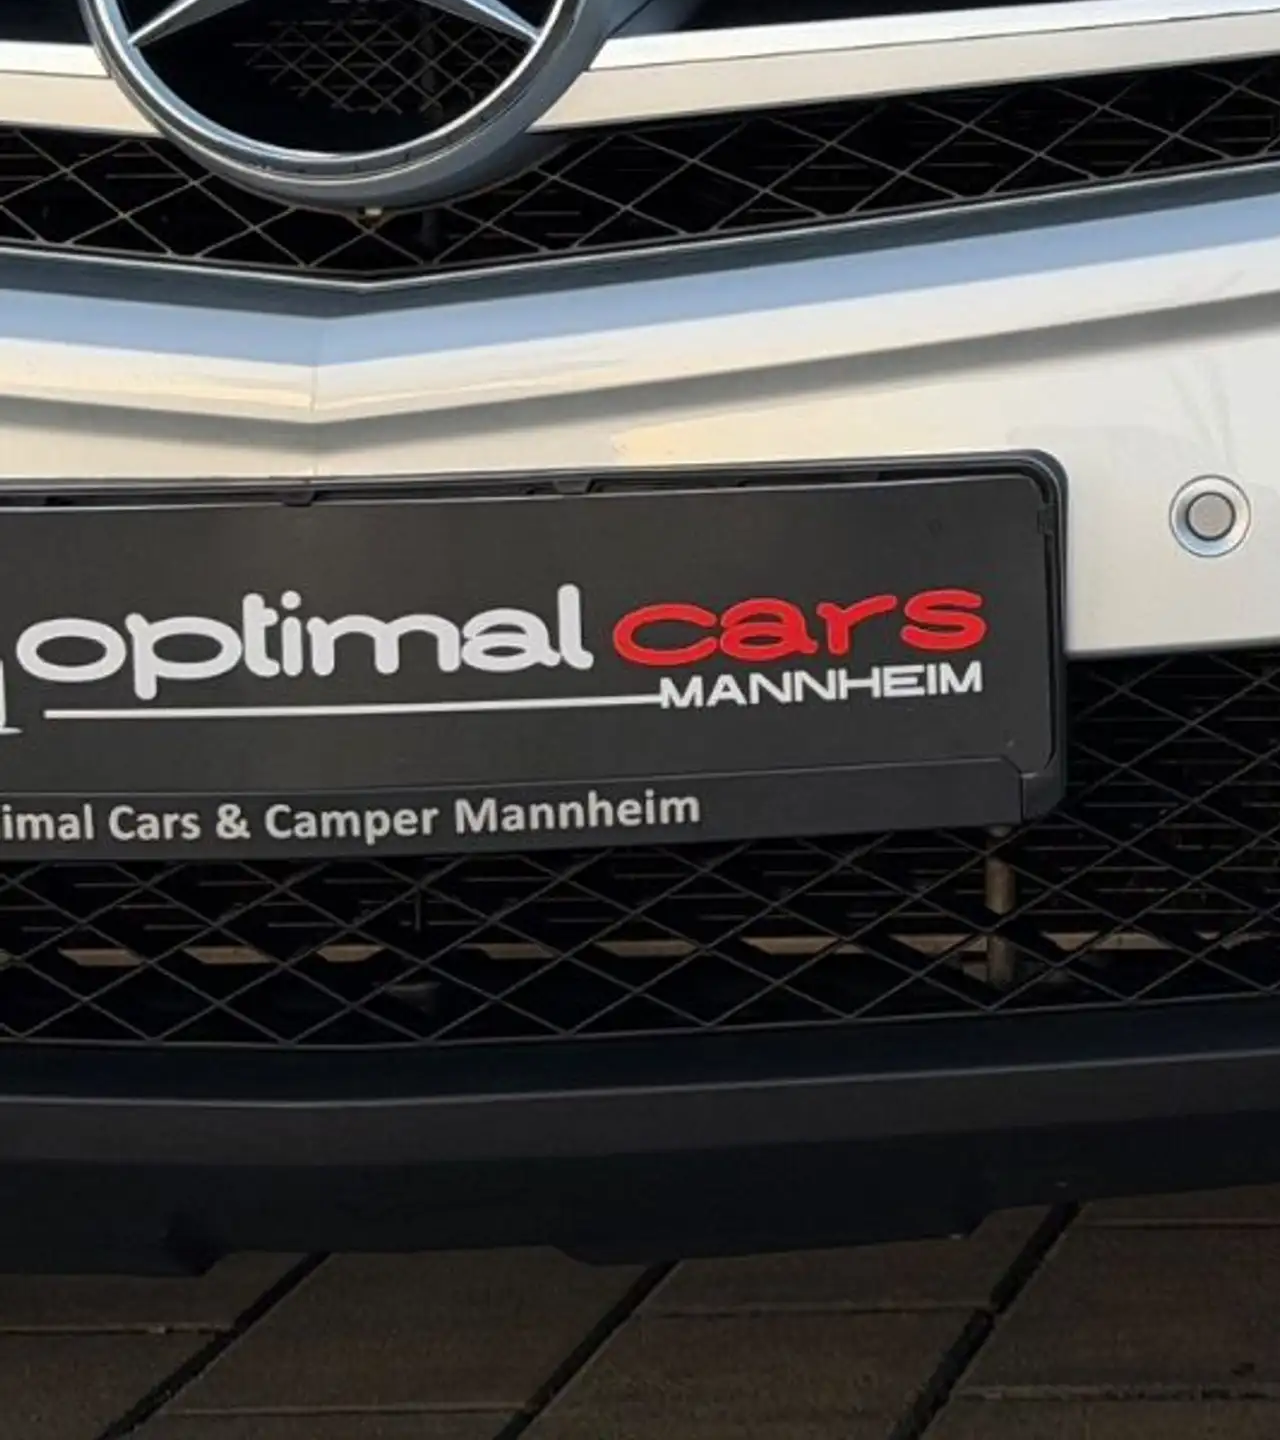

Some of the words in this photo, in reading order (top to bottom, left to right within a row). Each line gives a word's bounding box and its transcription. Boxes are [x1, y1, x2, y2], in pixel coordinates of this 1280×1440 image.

[16, 583, 594, 700] optimal
[612, 588, 988, 666] cars
[659, 660, 983, 709] MANNHEIM
[108, 805, 201, 840] Cars
[215, 803, 251, 839] &
[265, 802, 439, 845] Camper
[454, 789, 701, 834] Mannheim
